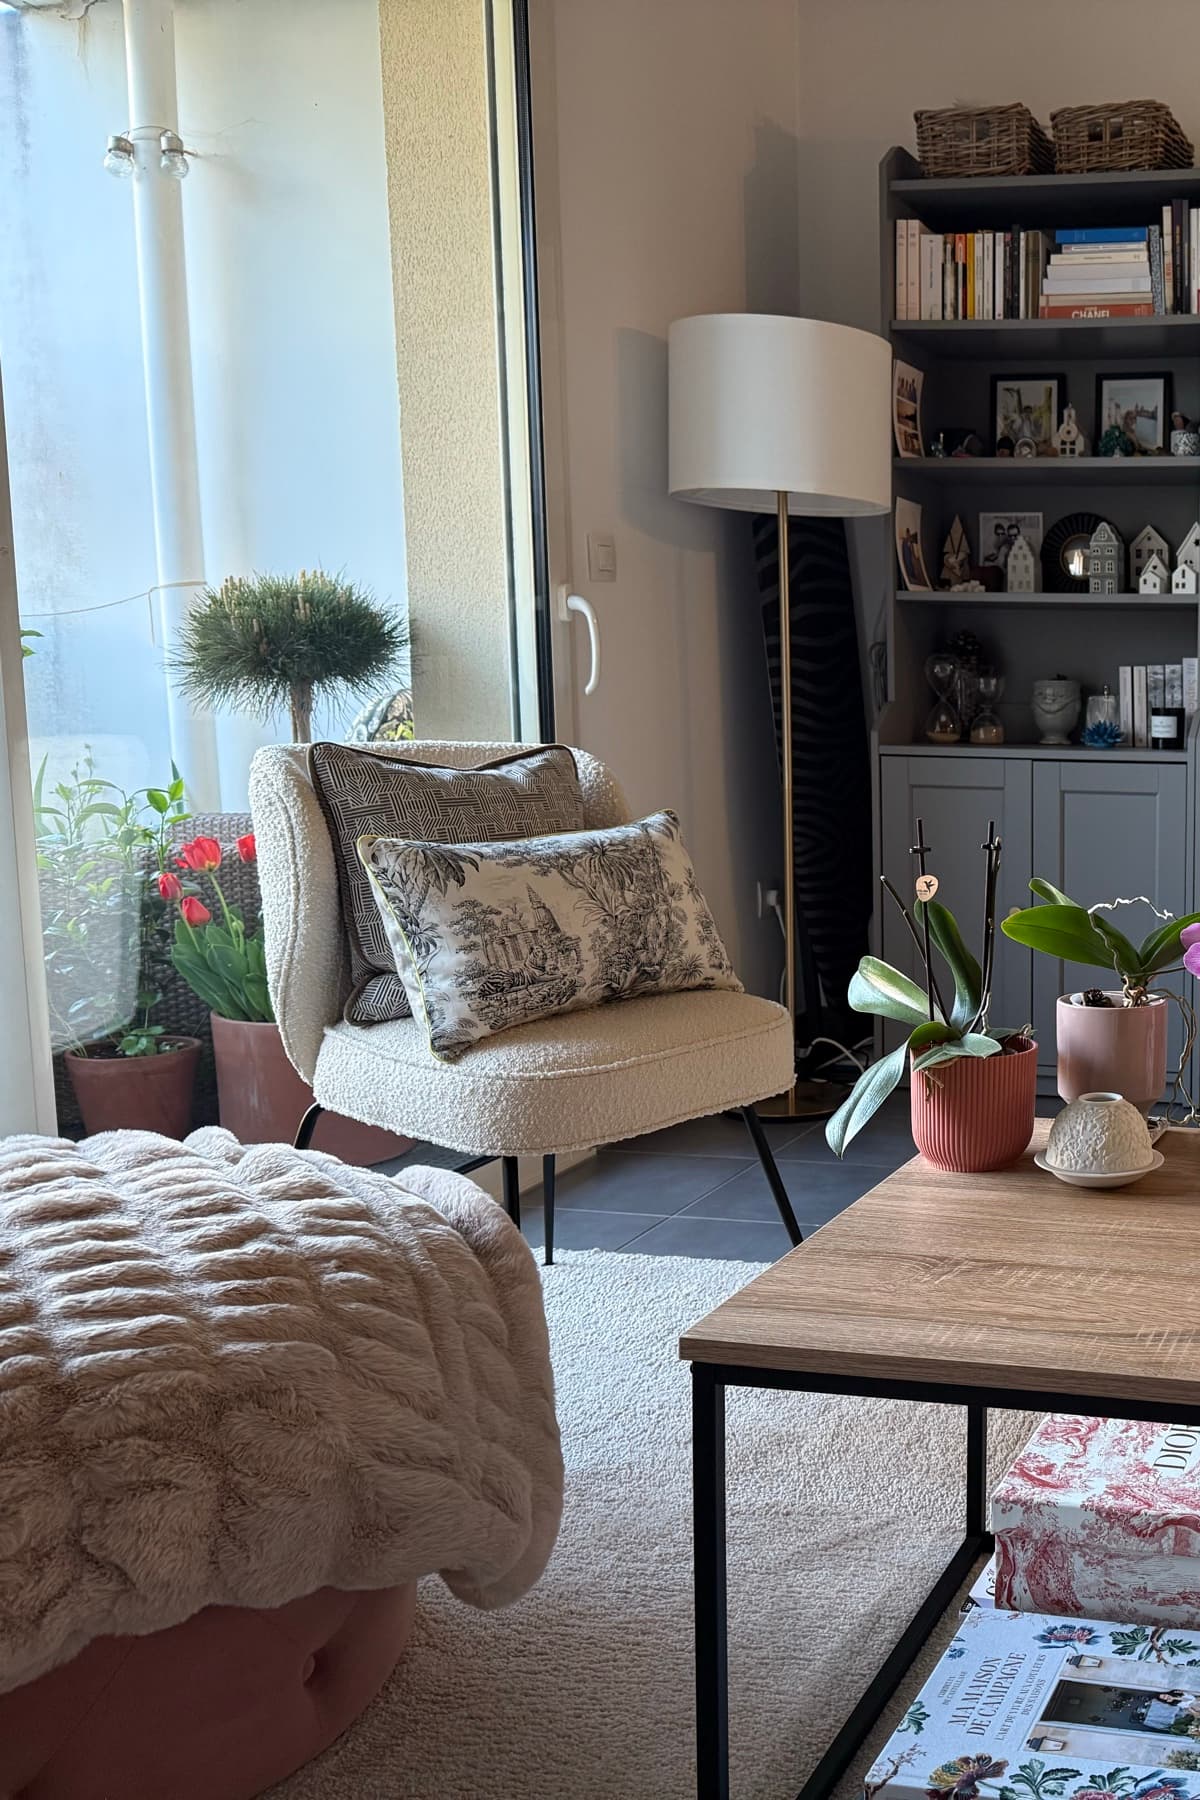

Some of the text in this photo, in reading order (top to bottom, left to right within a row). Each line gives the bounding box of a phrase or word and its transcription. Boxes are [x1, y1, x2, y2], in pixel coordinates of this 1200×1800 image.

[1152, 1425, 1200, 1471] DIO
[948, 1656, 1002, 1726] MA MAISON
[967, 1652, 1027, 1736] DE CAMPAGNE
